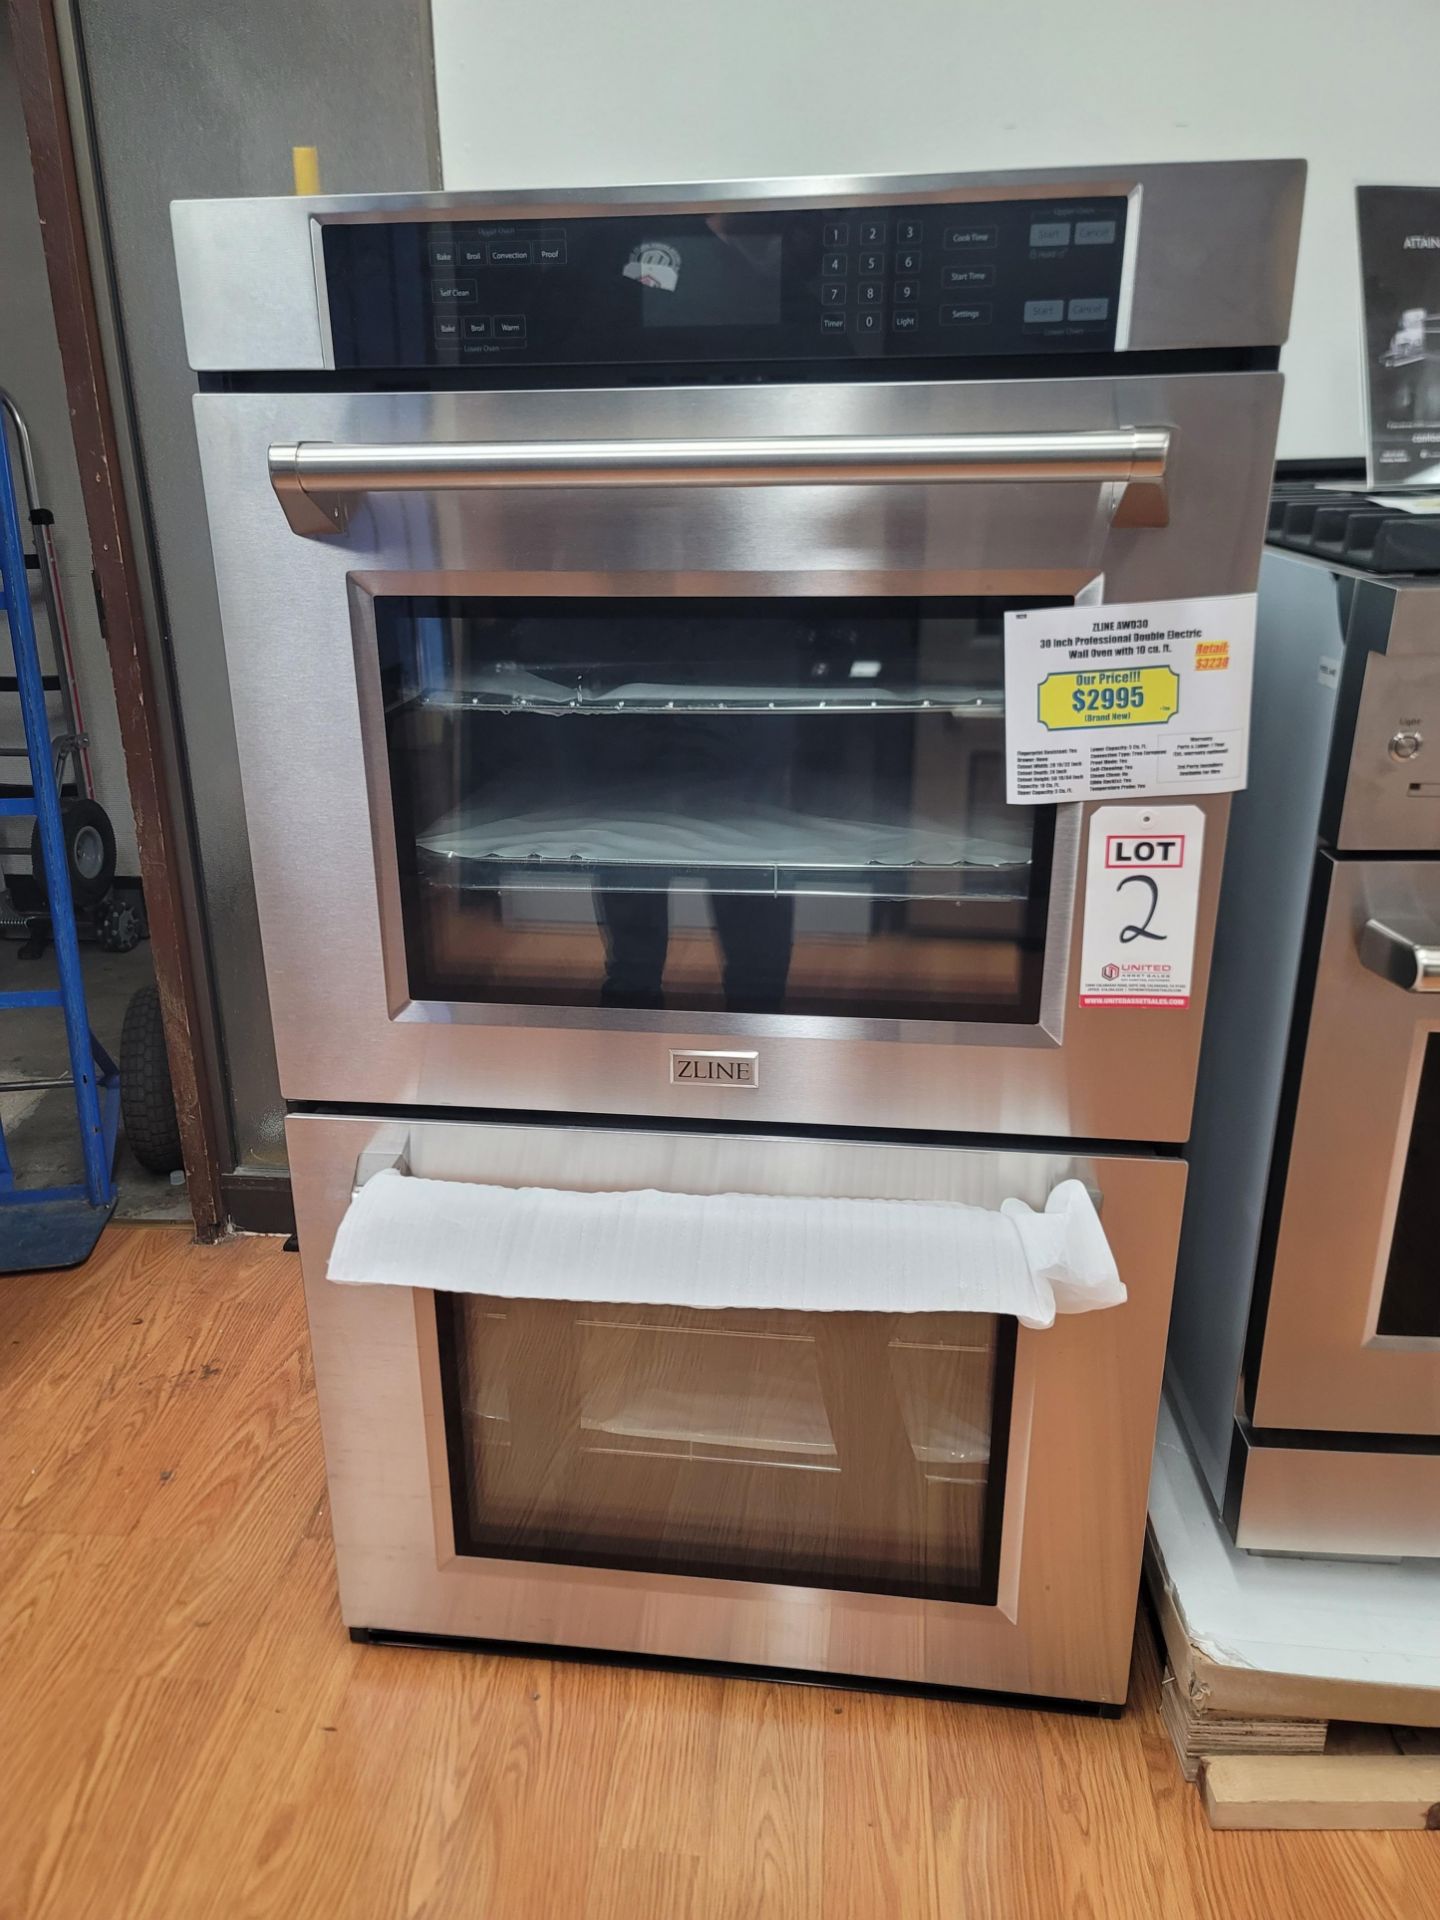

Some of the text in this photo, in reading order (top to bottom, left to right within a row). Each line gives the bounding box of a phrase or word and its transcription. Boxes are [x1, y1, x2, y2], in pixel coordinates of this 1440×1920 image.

[833, 229, 839, 240] 1
[869, 228, 877, 240] 2
[906, 226, 913, 238] 3
[953, 233, 989, 243] Cook Time
[436, 253, 452, 261] Bake
[466, 252, 481, 260] Broil
[492, 251, 528, 260] Convection
[541, 250, 559, 259] Proof
[831, 259, 839, 270] 4
[868, 257, 875, 269] 5
[904, 257, 912, 268] 6
[951, 272, 986, 281] Start Time
[452, 289, 470, 297] Clean
[831, 289, 838, 300] 7
[867, 288, 874, 299] 8
[903, 287, 911, 298] 9
[952, 310, 980, 319] Settings
[470, 323, 485, 332] Broil
[501, 323, 520, 332] Warm
[823, 319, 843, 328] Timer
[866, 316, 873, 328] 0
[896, 317, 915, 327] Light
[1092, 621, 1115, 633] ZLINE
[1040, 638, 1052, 649] 30
[1075, 633, 1132, 647] Professional
[1133, 631, 1165, 642] Double
[1167, 628, 1203, 640] Electric
[1069, 649, 1089, 660] Wall
[1091, 648, 1113, 659] Oven
[1114, 646, 1134, 657] with
[1136, 645, 1146, 656] 10
[1076, 671, 1141, 686] Our Price!!!
[1072, 686, 1144, 713] $2995
[1085, 712, 1131, 722] (Brand New)
[1115, 842, 1175, 861] LOT
[1116, 875, 1168, 944] 2
[1121, 964, 1171, 972] UNITED
[678, 1060, 751, 1080] ZLINE
